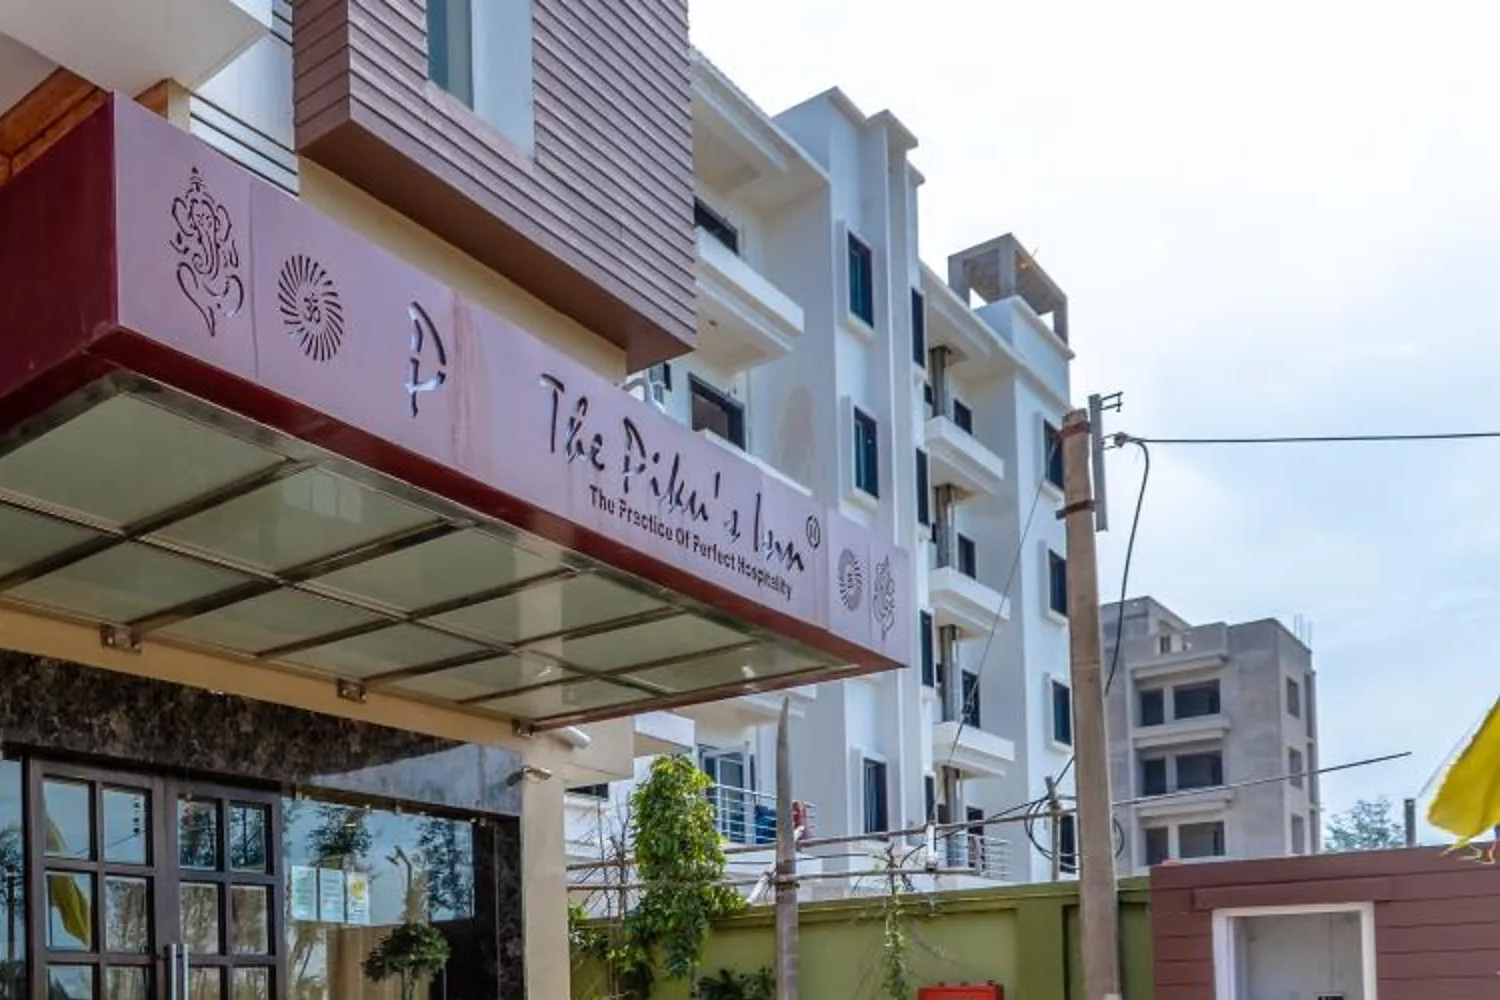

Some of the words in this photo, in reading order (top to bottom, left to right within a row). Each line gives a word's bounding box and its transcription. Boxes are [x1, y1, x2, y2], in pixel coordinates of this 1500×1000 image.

[540, 372, 605, 471] The
[753, 491, 805, 572] Inn
[588, 483, 616, 515] The
[618, 498, 673, 541] Practice
[675, 527, 690, 549] Of
[692, 533, 737, 571] Perfect
[737, 554, 792, 601] Hospitality
